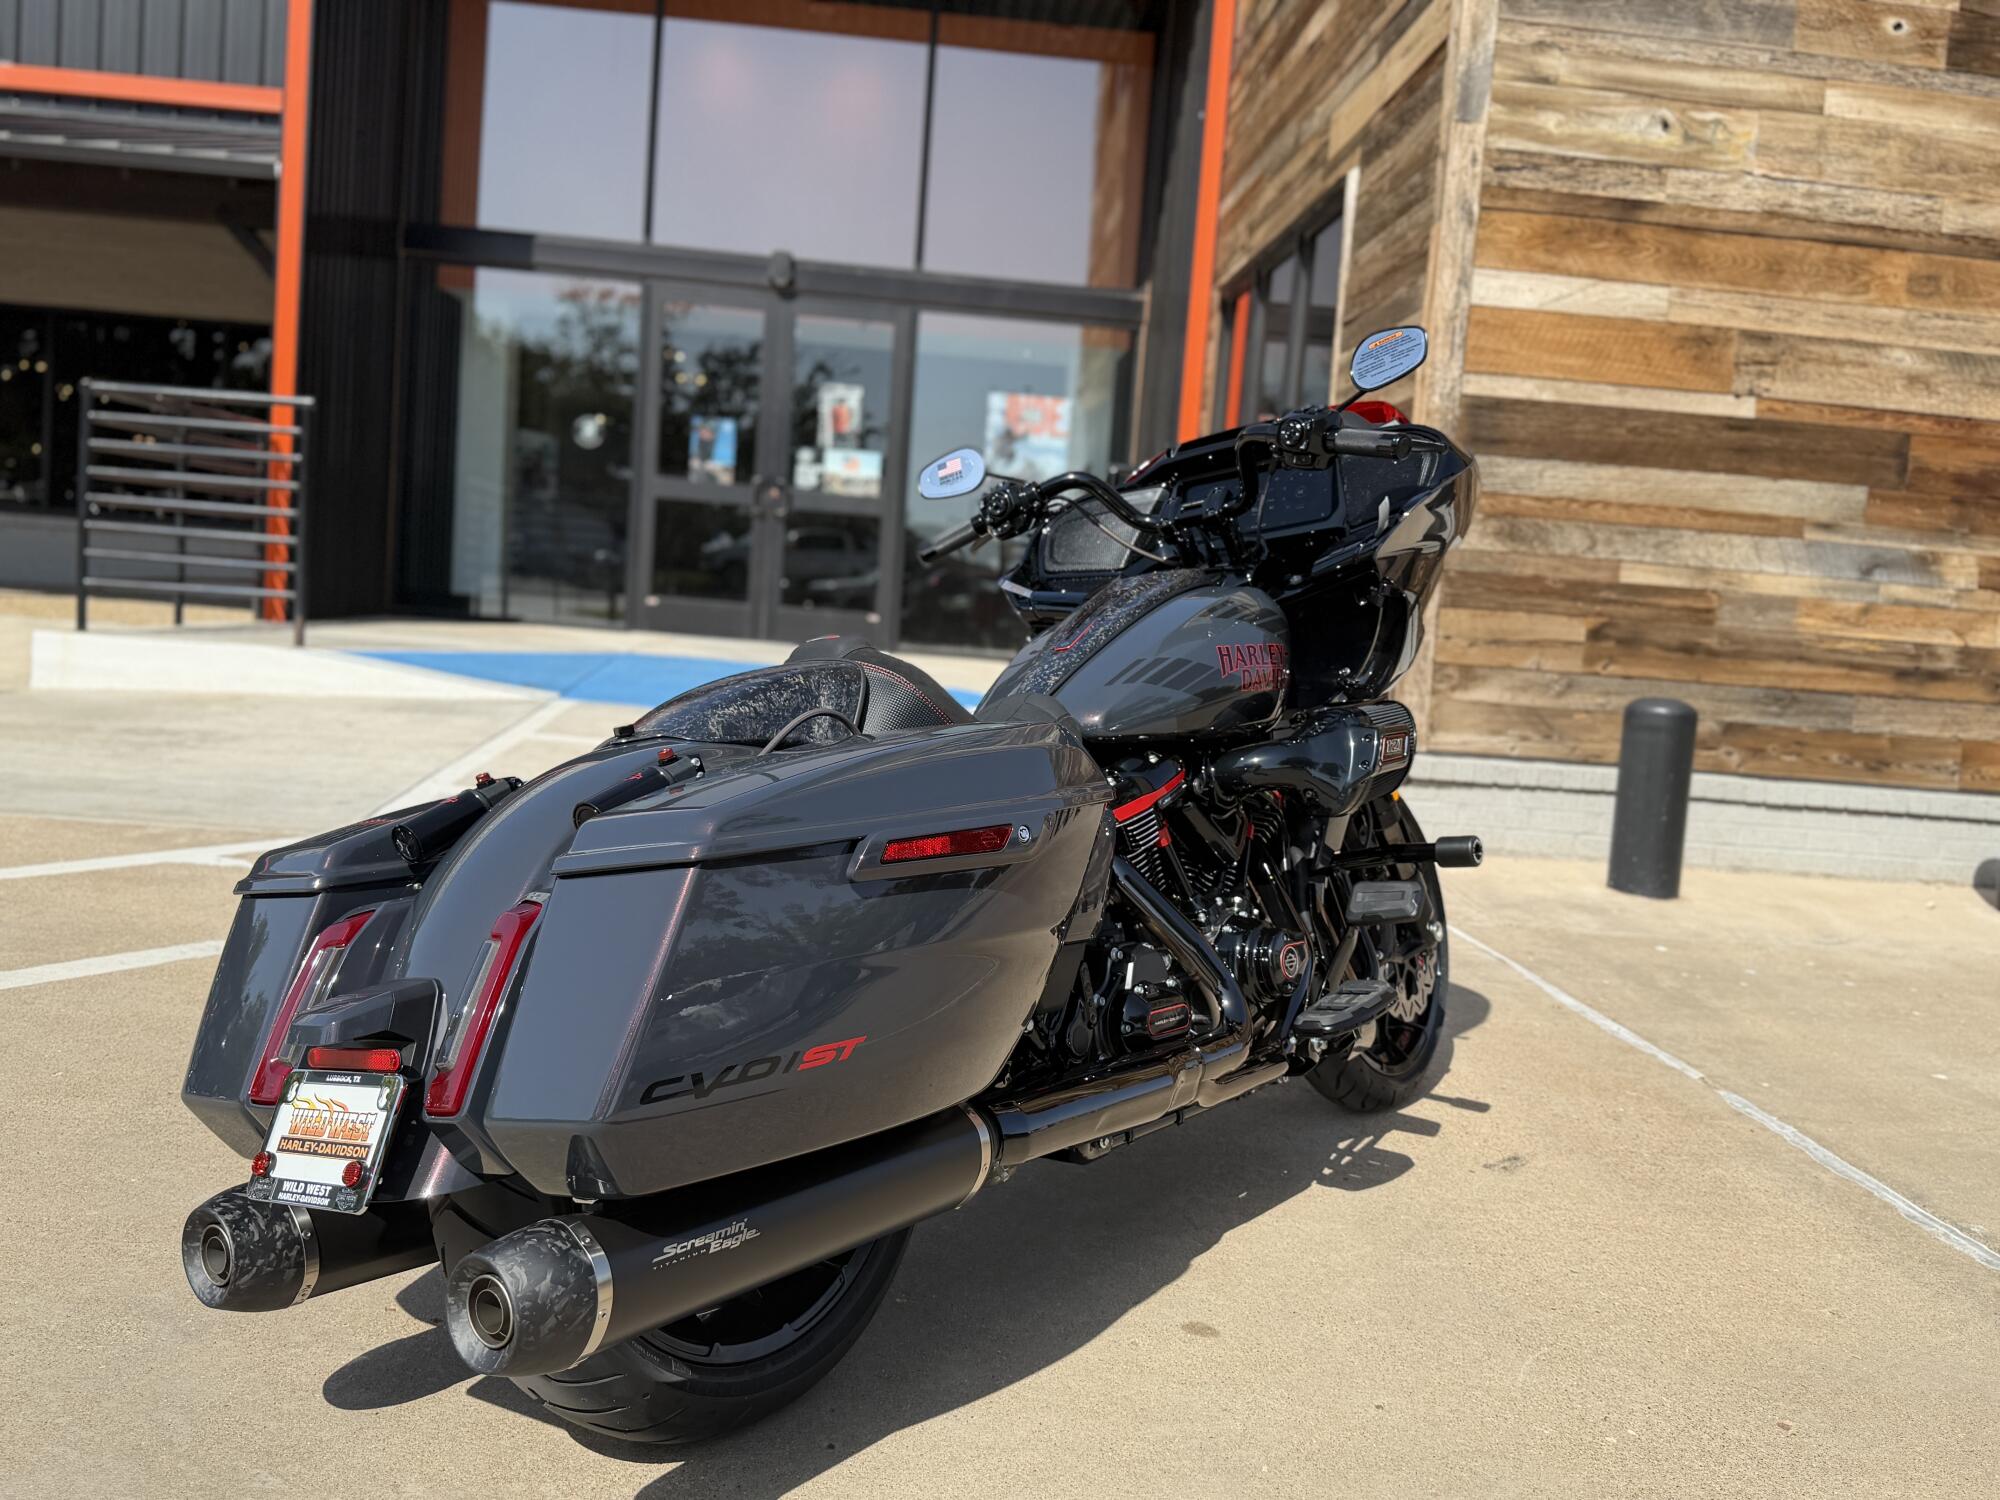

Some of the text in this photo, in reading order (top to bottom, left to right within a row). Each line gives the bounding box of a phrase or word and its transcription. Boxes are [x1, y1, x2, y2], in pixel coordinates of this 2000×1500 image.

[353, 1075, 361, 1083] TX
[288, 1107, 378, 1142] WILD WEST
[279, 1138, 370, 1159] HARLEY-DAVIDSON
[282, 1180, 305, 1194] WILD
[306, 1183, 333, 1197] WEST
[278, 1191, 331, 1206] HARLEY-DAVIDSON
